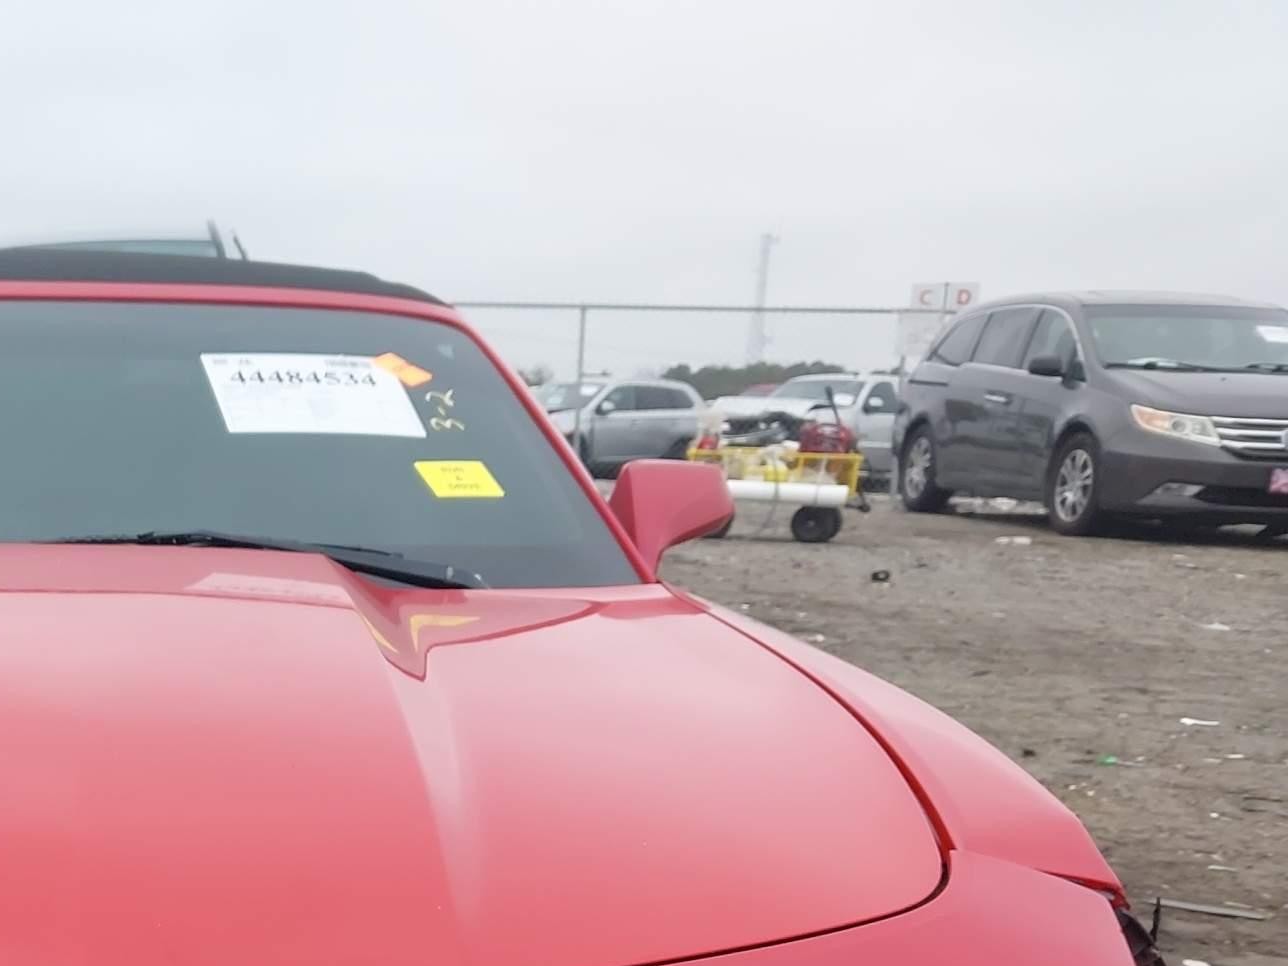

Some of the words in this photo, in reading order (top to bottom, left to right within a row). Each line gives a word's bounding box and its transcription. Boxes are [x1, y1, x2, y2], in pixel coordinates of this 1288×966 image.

[919, 287, 933, 305] C
[956, 287, 972, 305] D
[230, 370, 377, 387] 44484534
